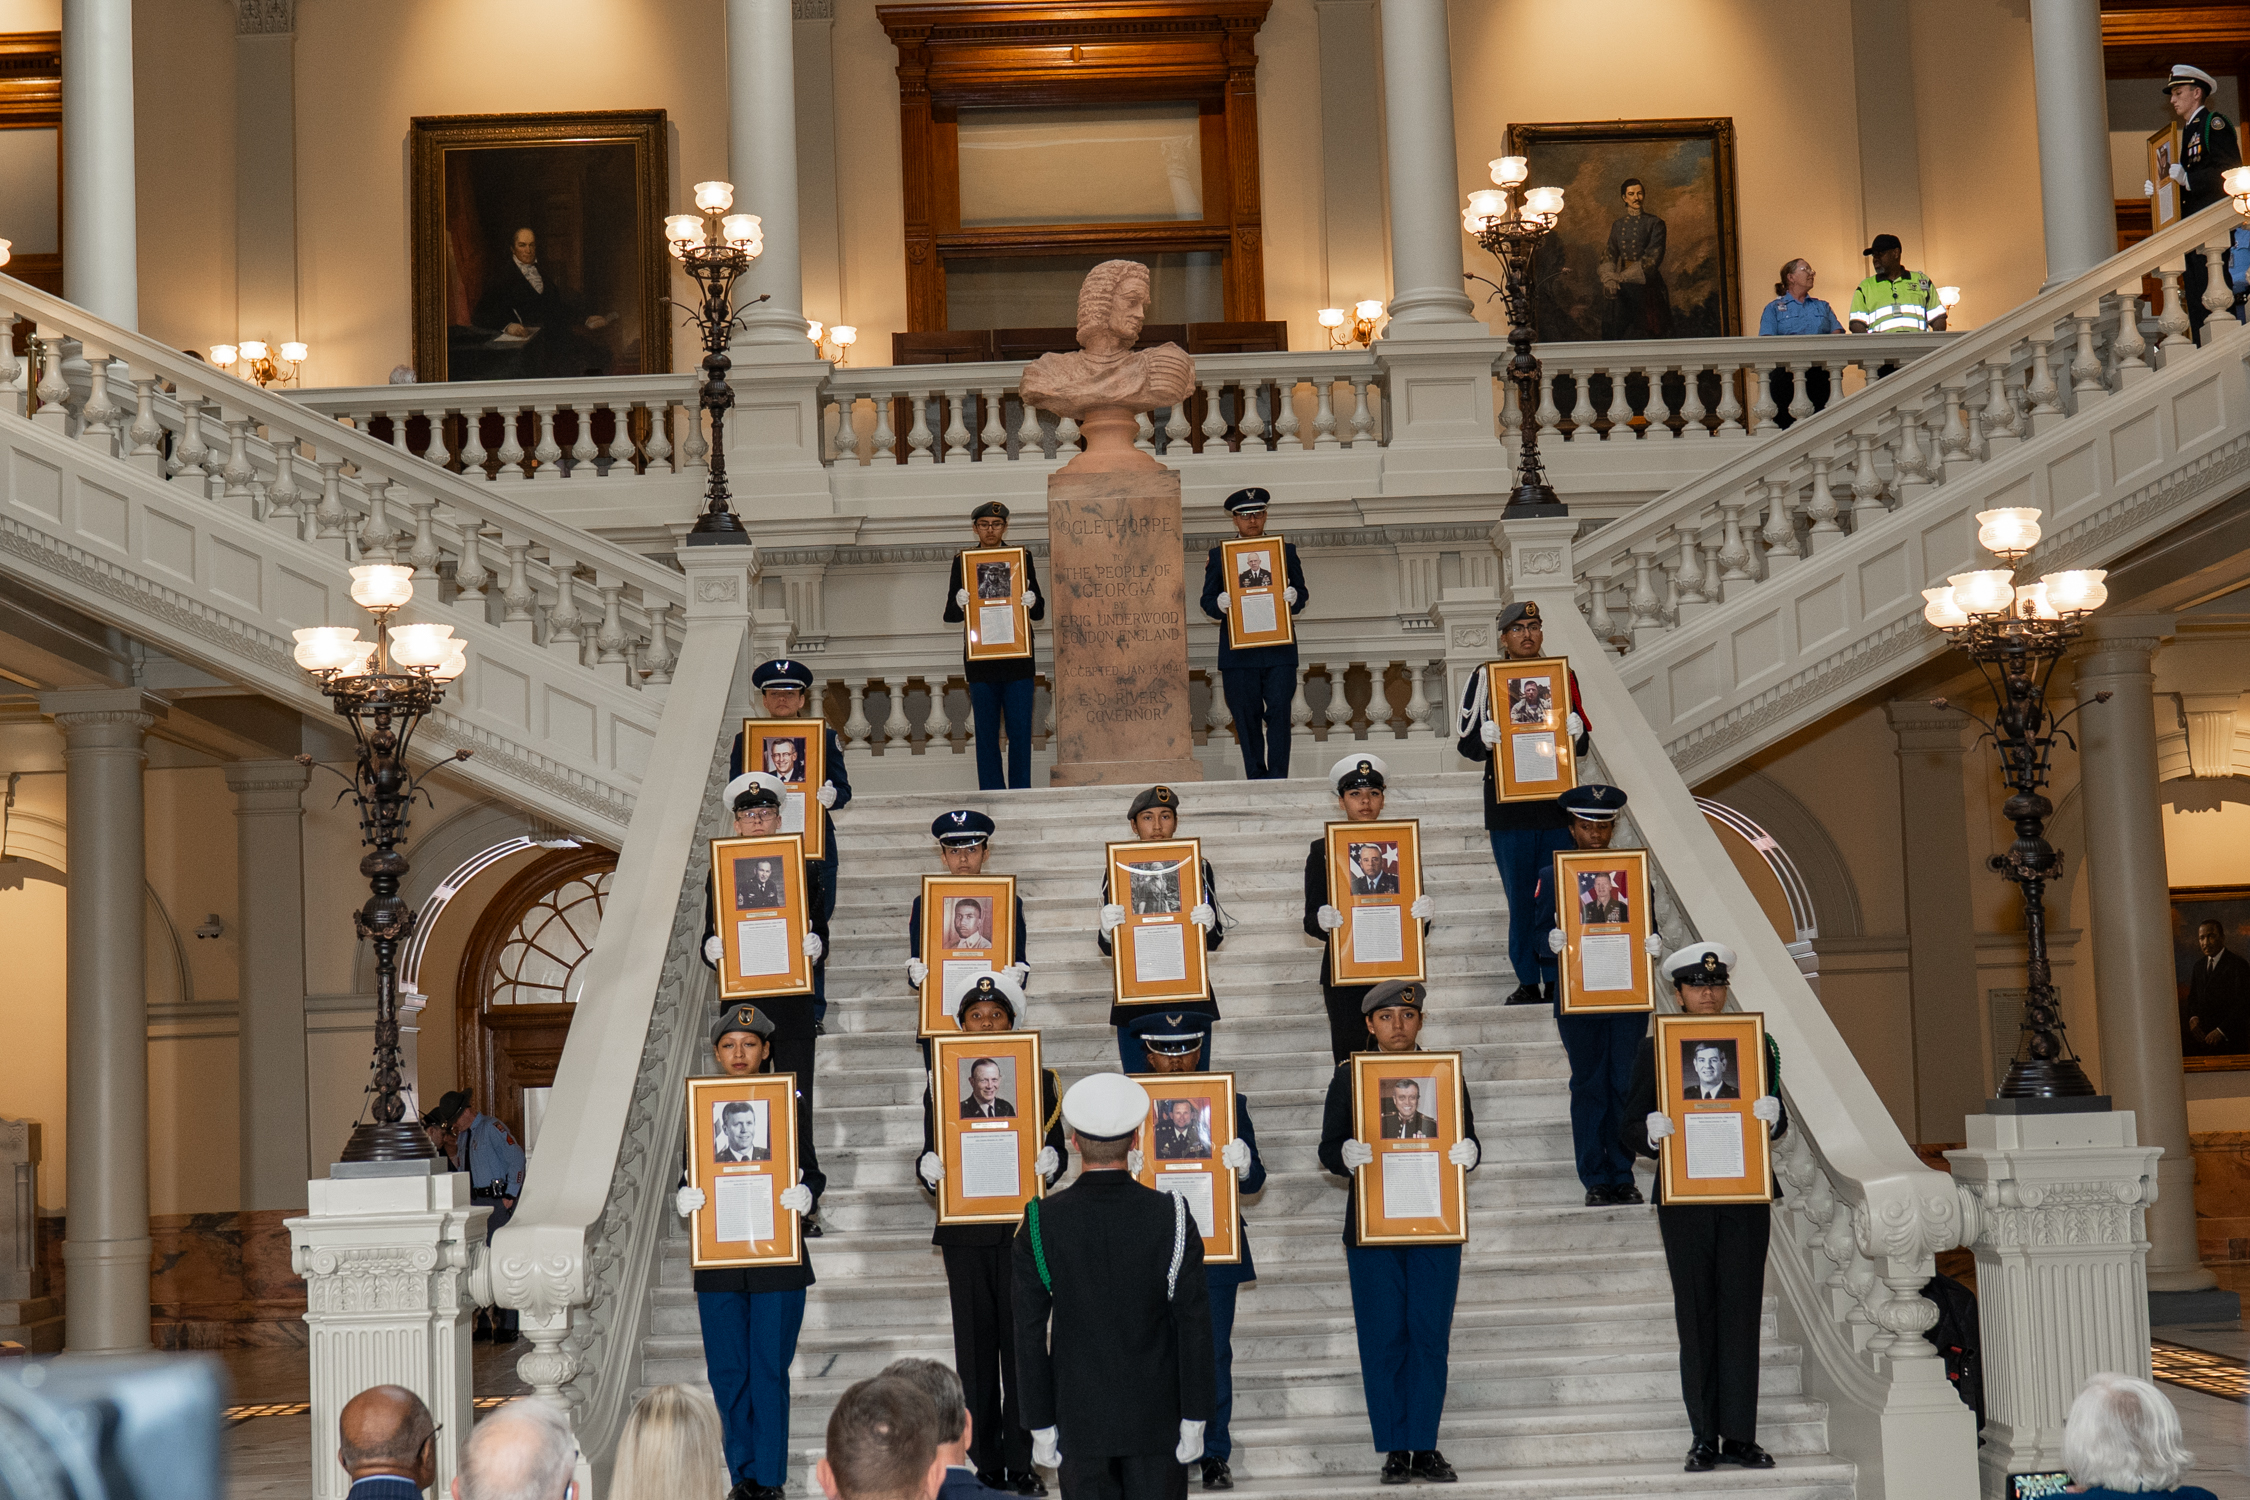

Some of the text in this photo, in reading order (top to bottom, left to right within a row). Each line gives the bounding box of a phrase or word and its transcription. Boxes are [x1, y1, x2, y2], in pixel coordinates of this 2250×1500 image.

[1112, 553, 1123, 562] TO
[1063, 563, 1171, 580] THE PEOPLE OF
[1082, 582, 1156, 598] GEORGIA
[1113, 601, 1125, 610] BY
[1097, 611, 1179, 627] UNDERWOOD
[1119, 627, 1180, 643] ENGLAND
[1063, 665, 1119, 678] ACCEPTED
[1162, 663, 1182, 674] 1941
[1116, 690, 1167, 705] RIVERS
[1086, 708, 1163, 723] GOVERNOR
